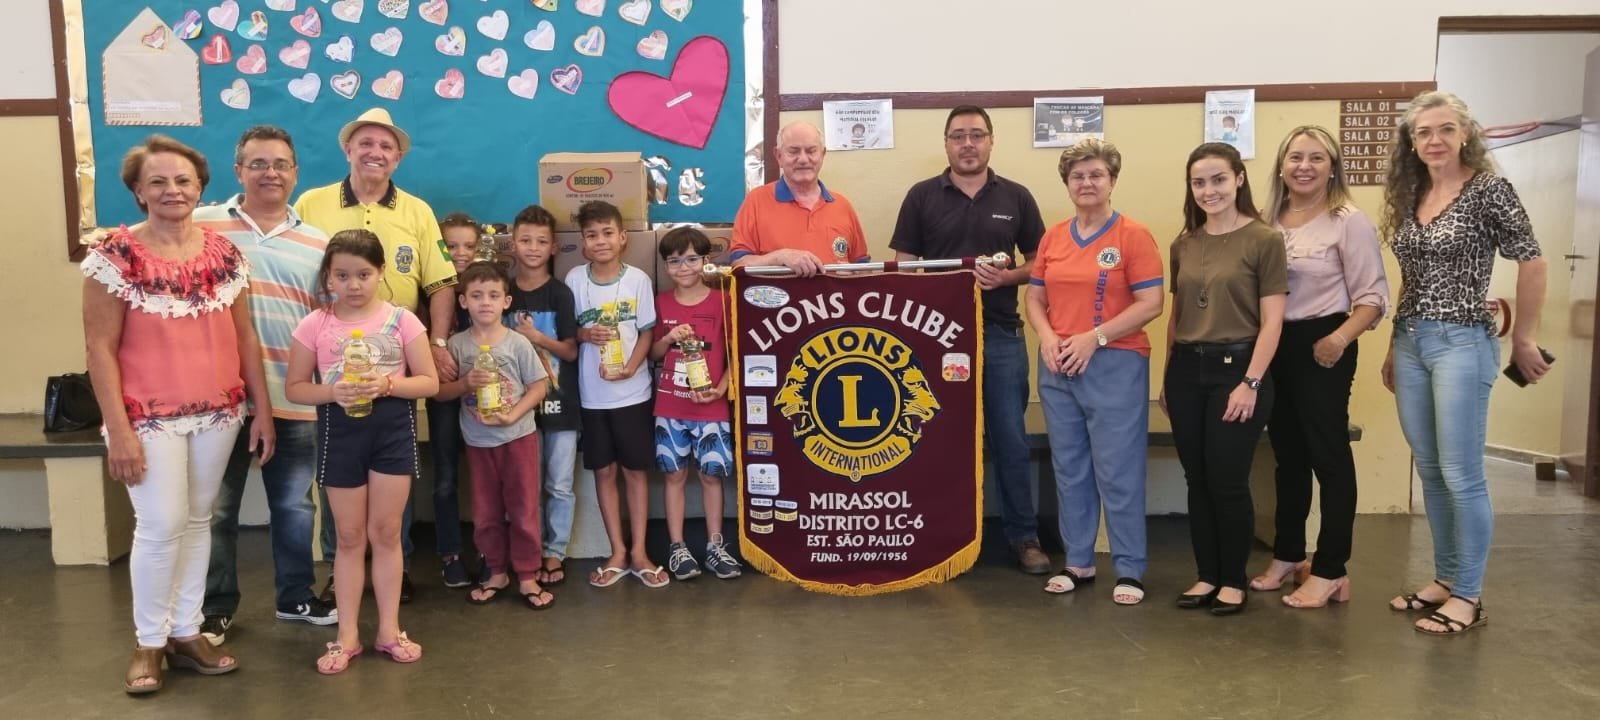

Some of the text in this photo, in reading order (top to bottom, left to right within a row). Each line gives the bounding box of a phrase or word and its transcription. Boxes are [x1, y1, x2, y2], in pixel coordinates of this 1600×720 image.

[1346, 102, 1390, 112] SALA 01
[1345, 116, 1390, 127] SALA 02
[1344, 131, 1390, 141] SALA 03
[1343, 145, 1388, 156] SALA 04
[1343, 160, 1370, 170] SALA
[574, 176, 605, 186] BREJEIRO
[1345, 174, 1369, 184] ALA
[1094, 271, 1108, 312] CLUBE
[748, 291, 964, 352] LIONS CLUBE
[807, 331, 906, 366] LIONS
[838, 375, 881, 428] L
[810, 440, 905, 471] INTERNATIONAL
[809, 490, 912, 510] MIRASSOL
[799, 514, 879, 531] DISTRITO
[885, 513, 924, 531] LC-6
[807, 533, 915, 547] EST. SÃO PAULO
[810, 551, 908, 562] FUND. 19/09/1956
